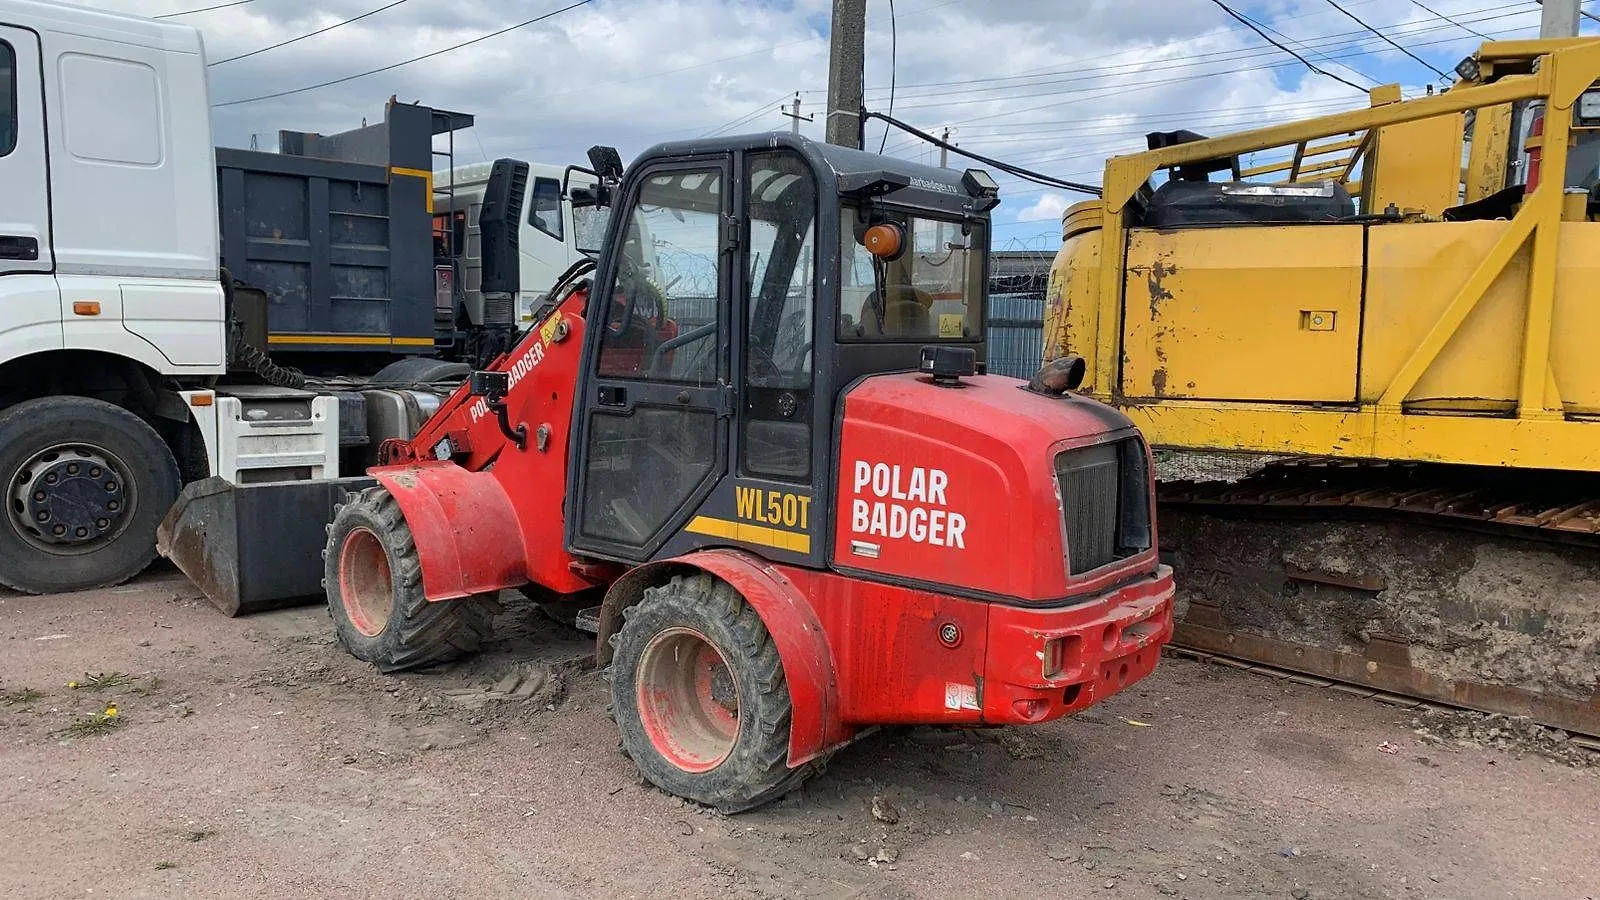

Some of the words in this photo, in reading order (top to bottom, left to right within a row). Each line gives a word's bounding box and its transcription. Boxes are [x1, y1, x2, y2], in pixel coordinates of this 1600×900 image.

[470, 396, 489, 424] POL
[854, 460, 948, 505] POLAR
[735, 485, 811, 529] WL50T
[852, 499, 966, 549] BADGER
